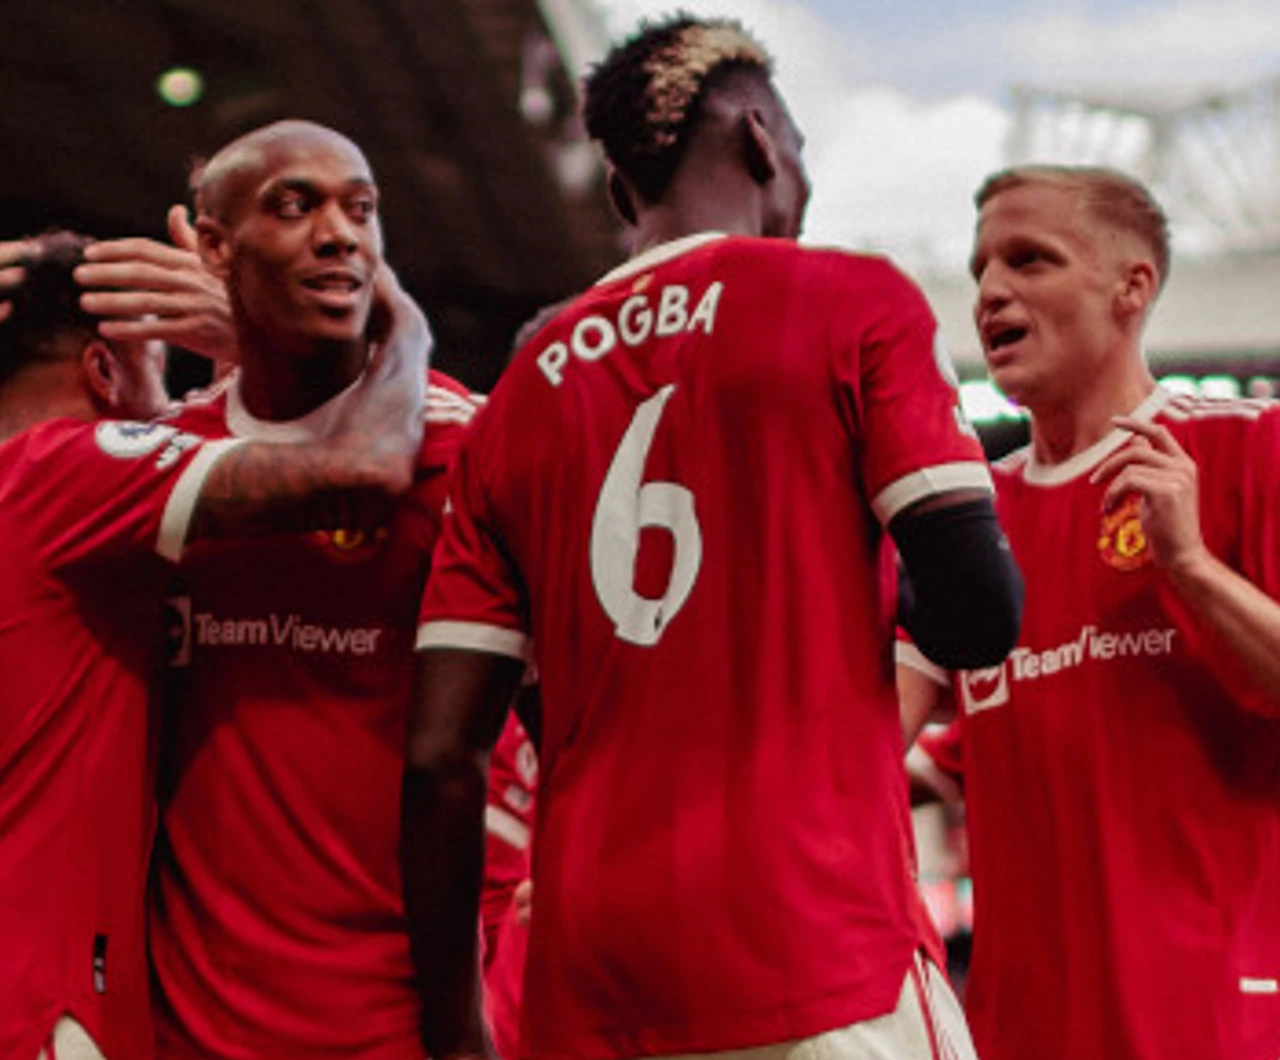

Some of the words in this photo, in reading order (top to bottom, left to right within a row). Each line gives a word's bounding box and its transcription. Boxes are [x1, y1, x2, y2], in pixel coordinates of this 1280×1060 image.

[536, 282, 723, 387] POGBA
[590, 384, 702, 646] 6
[195, 614, 381, 655] TeamViewer
[1010, 626, 1177, 681] TeamViewer
